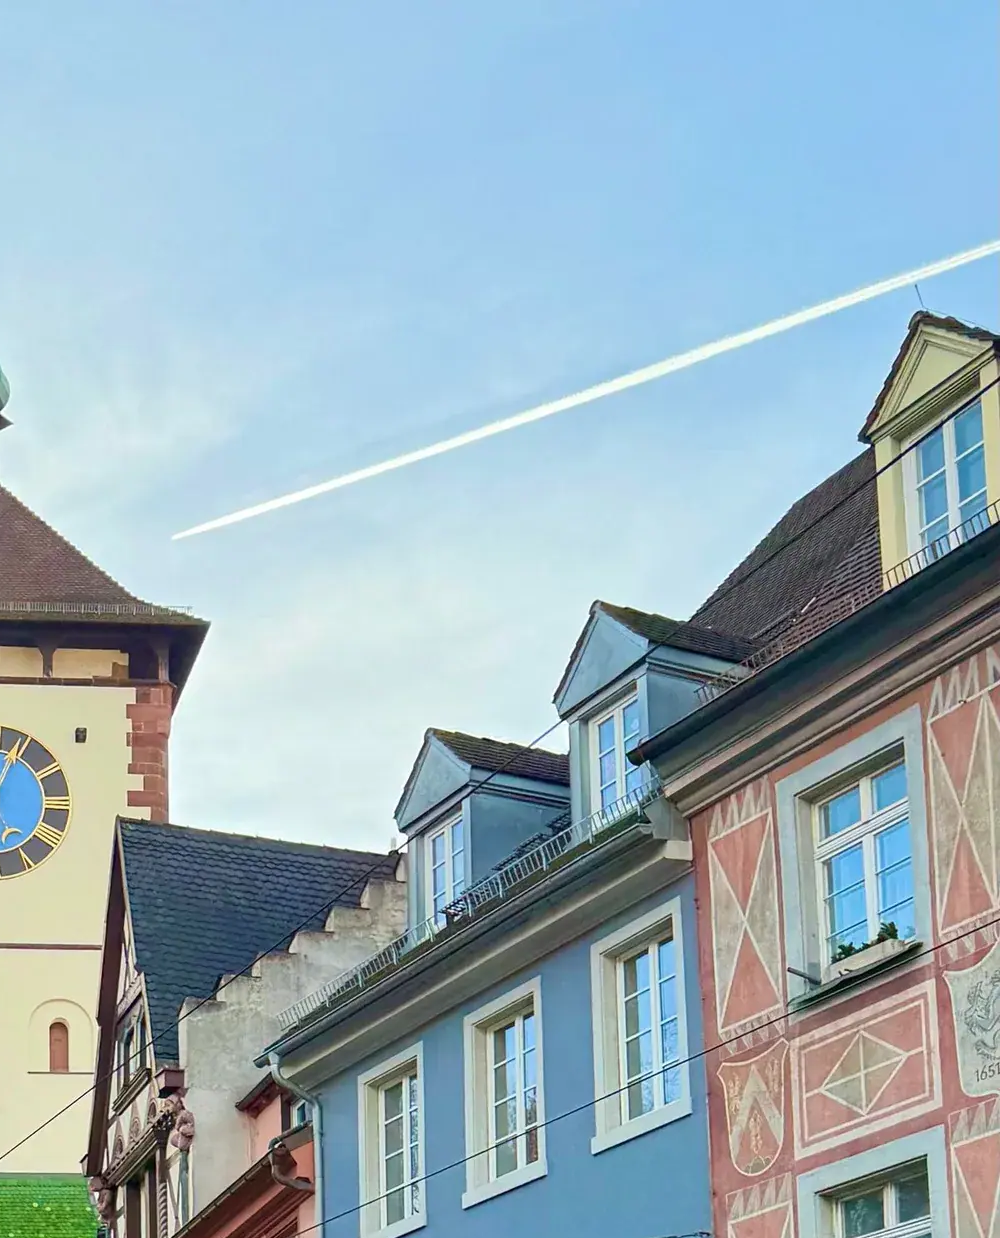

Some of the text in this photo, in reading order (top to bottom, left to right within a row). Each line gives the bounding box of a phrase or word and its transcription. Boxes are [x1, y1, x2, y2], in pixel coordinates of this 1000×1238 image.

[37, 762, 61, 781] II
[44, 796, 70, 809] III
[18, 848, 36, 870] V
[974, 1062, 1000, 1082] 1651
